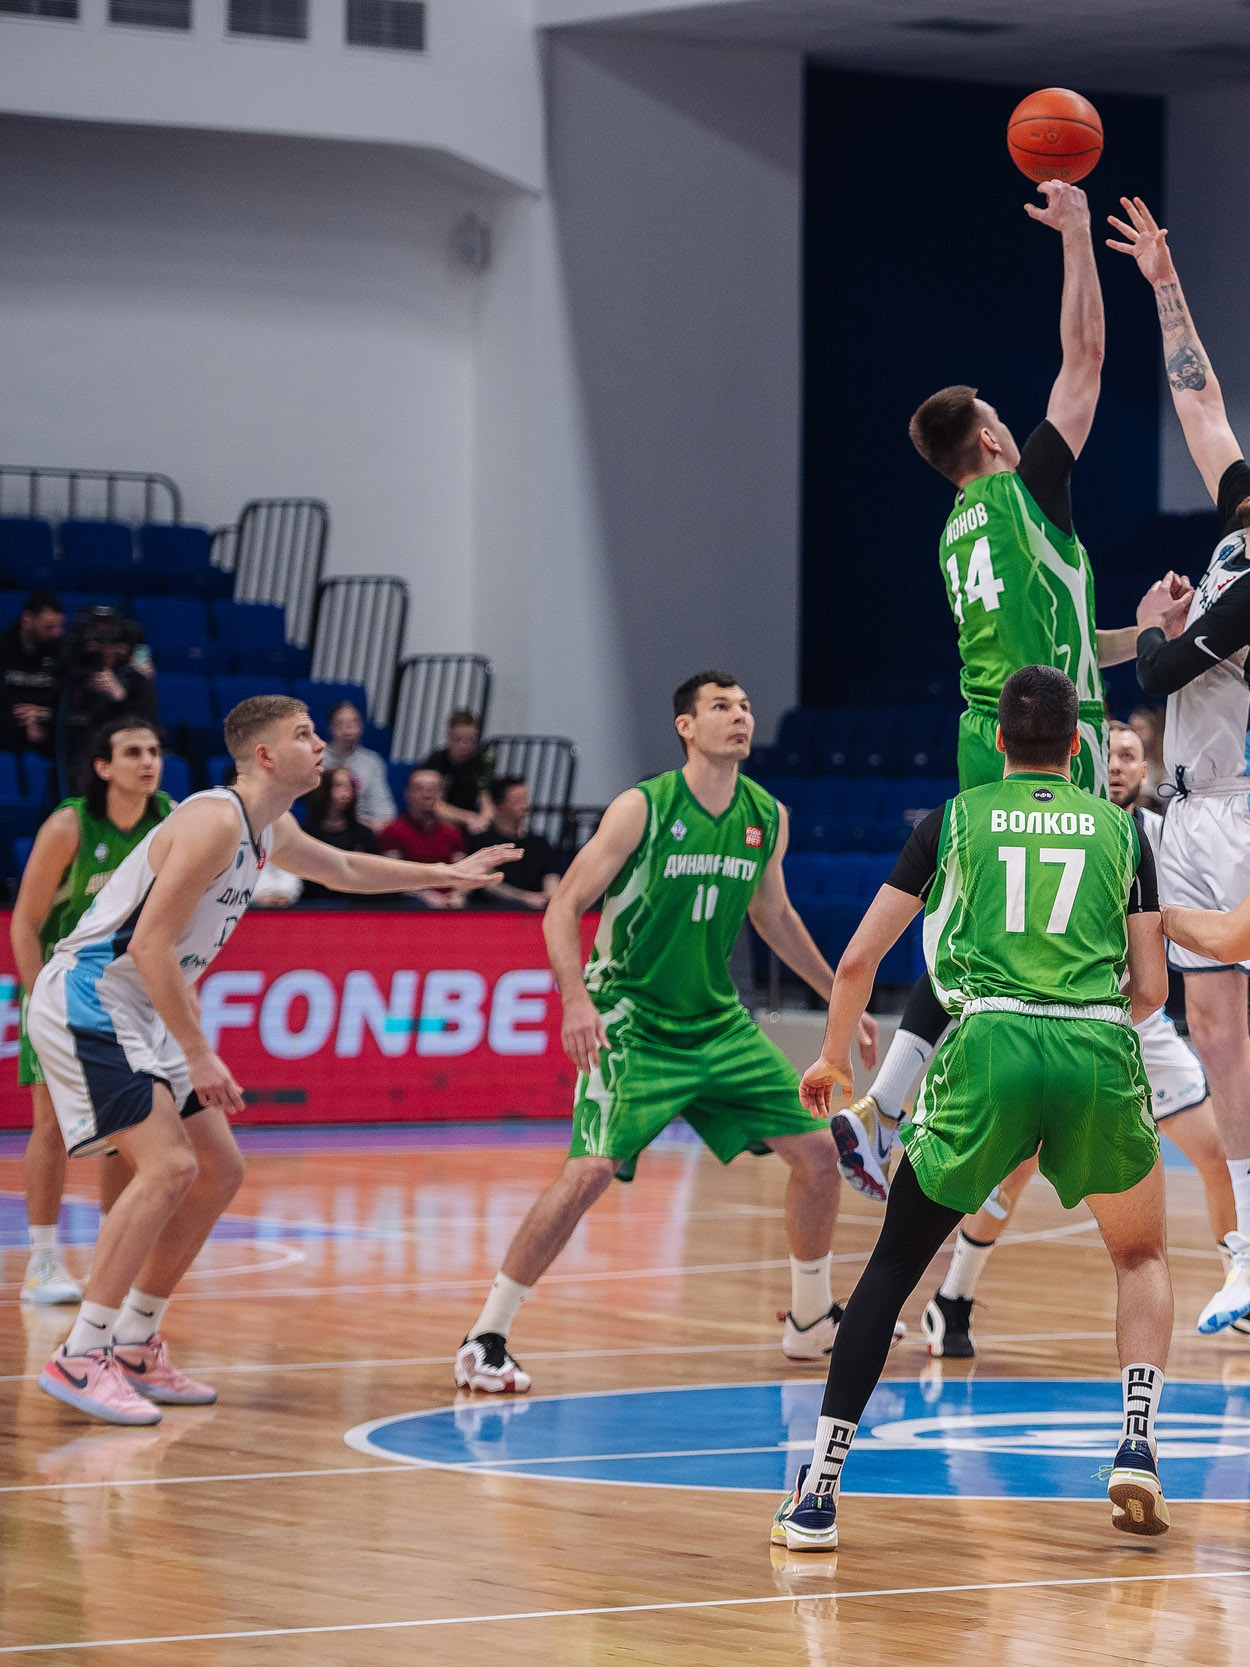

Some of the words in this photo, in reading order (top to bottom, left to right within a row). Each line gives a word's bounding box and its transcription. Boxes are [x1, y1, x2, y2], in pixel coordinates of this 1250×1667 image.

[946, 535, 1005, 624] 14
[991, 809, 1096, 836] ВОЛКОВ
[998, 846, 1086, 934] 17
[199, 969, 560, 1058] FONBE
